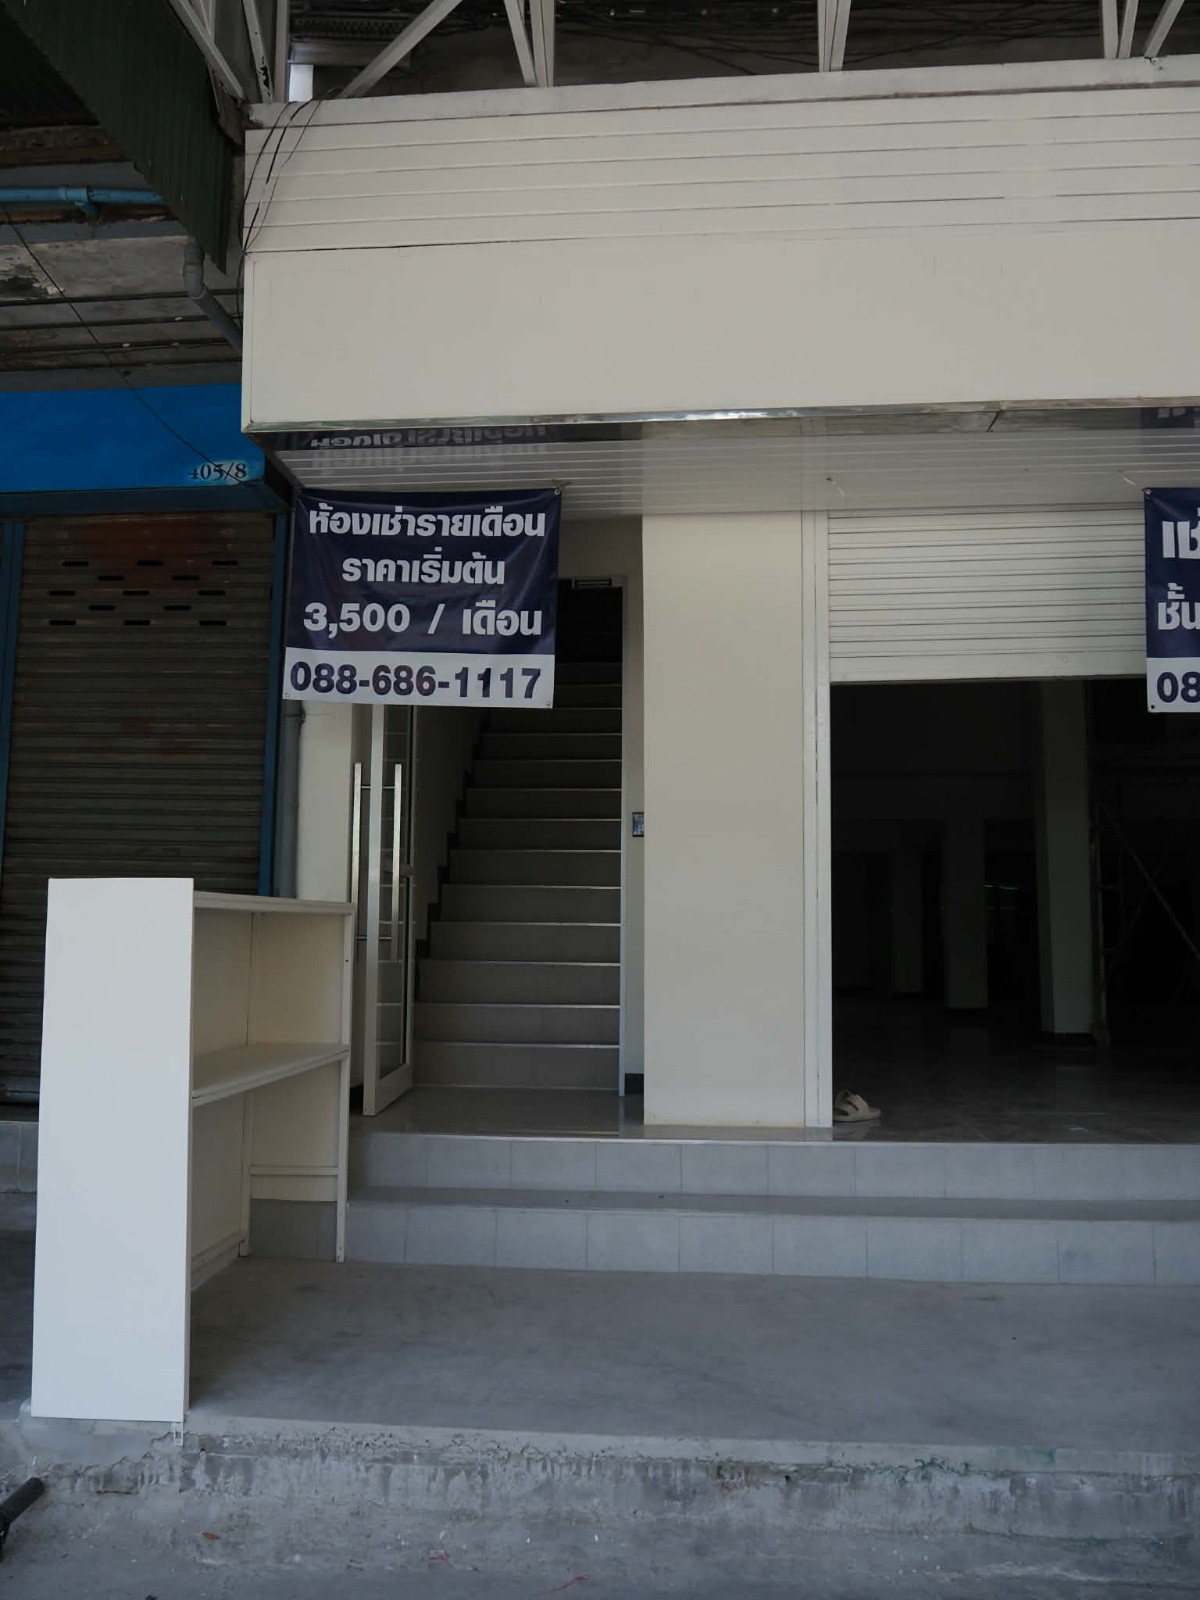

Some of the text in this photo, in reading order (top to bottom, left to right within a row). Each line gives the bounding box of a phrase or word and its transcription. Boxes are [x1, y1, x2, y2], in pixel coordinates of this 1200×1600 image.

[187, 462, 247, 480] 405/8
[309, 502, 546, 537] ห้องเช่ารายเดือน
[1161, 507, 1200, 560] เช
[341, 547, 506, 585] ราคาเริ่มต้น
[303, 599, 543, 639] 3,500 / เดือน
[290, 661, 542, 699] 088-686-1117
